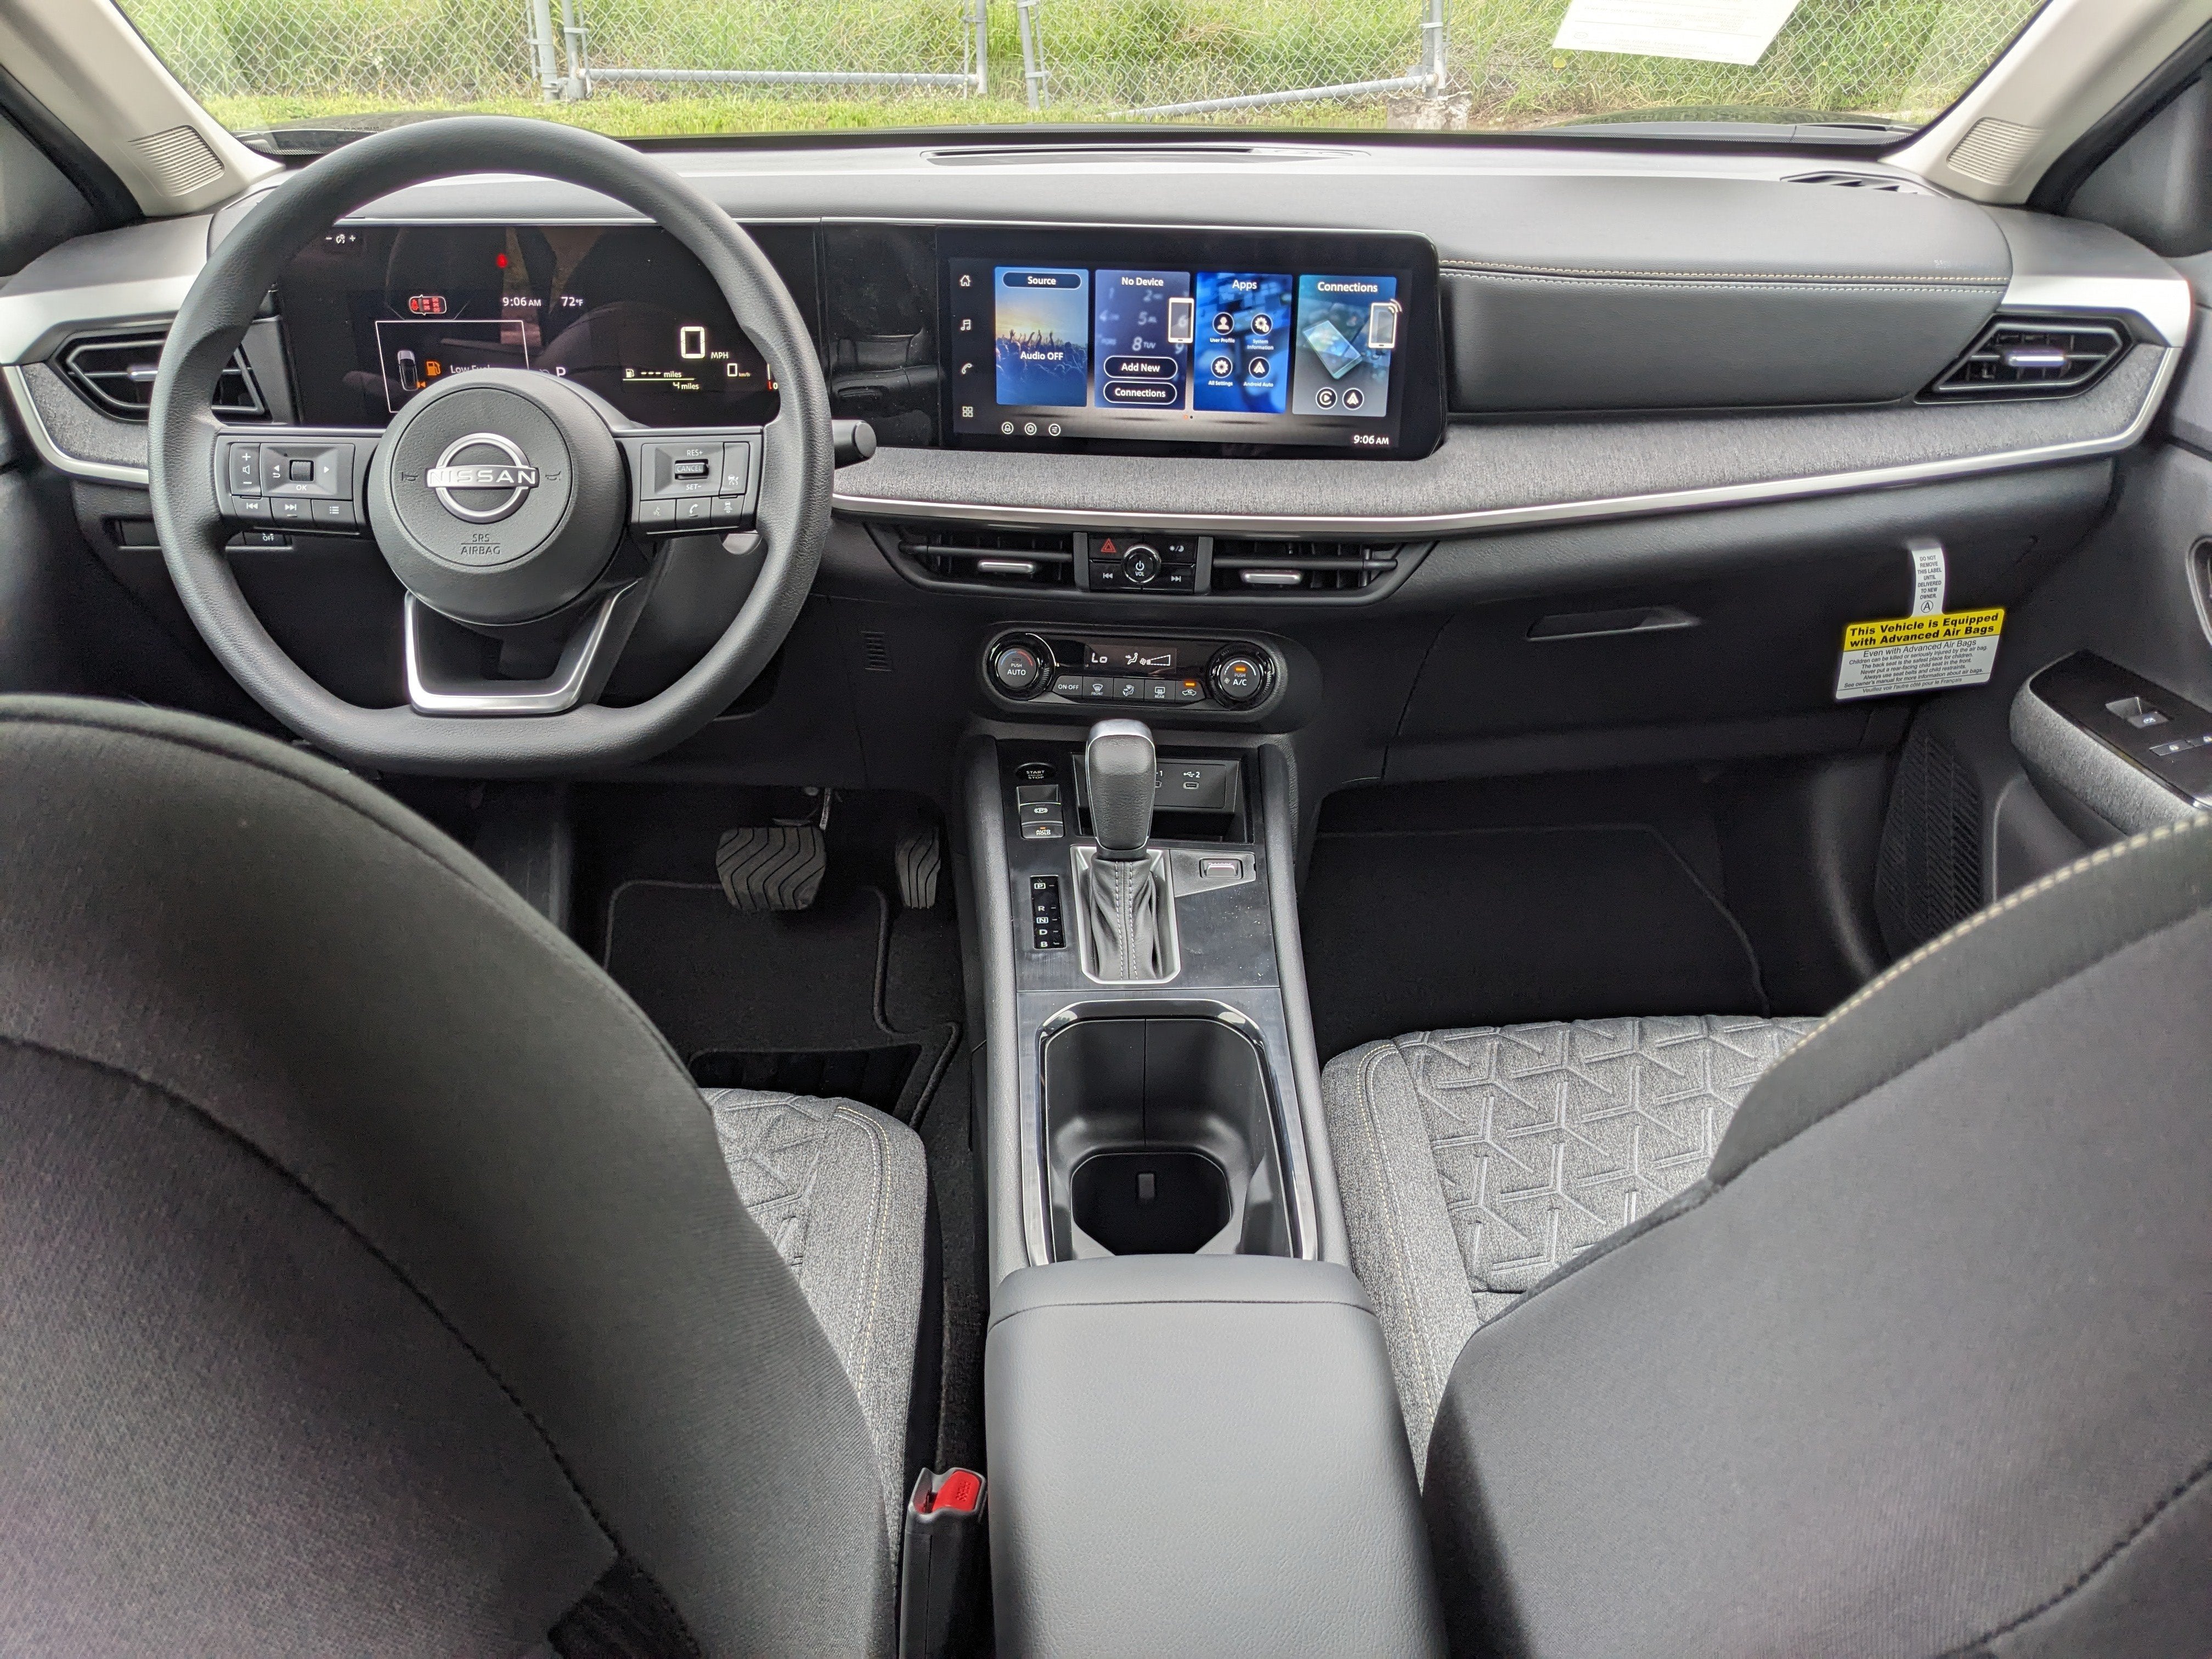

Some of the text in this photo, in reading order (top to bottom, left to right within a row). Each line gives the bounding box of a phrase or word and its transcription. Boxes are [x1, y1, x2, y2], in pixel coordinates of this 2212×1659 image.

[1028, 276, 1056, 286] Source
[1121, 277, 1164, 286] No Device
[1232, 280, 1257, 291] Apps
[1317, 282, 1378, 293] Connections
[502, 297, 527, 306] 9:06
[561, 297, 584, 307] 72°F
[1137, 311, 1148, 325] 5
[680, 326, 706, 359] 0
[1132, 336, 1142, 351] 8
[711, 351, 729, 360] MPH
[1020, 351, 1063, 361] Audio OFF
[556, 366, 566, 377] P
[727, 363, 737, 377] 0
[1121, 363, 1160, 373] Add New
[1115, 388, 1166, 398] Connections
[1353, 435, 1389, 444] 9:06 AM
[430, 469, 536, 485] NISSAN
[472, 533, 489, 543] SRS
[461, 545, 500, 555] AIRBAG
[1923, 602, 1931, 611] A
[1850, 612, 1999, 636] This Vehicle is Equipped
[1850, 625, 1994, 647] with Advanced Air Bags
[1903, 642, 1942, 653] Advanced
[1091, 652, 1108, 663] Lo
